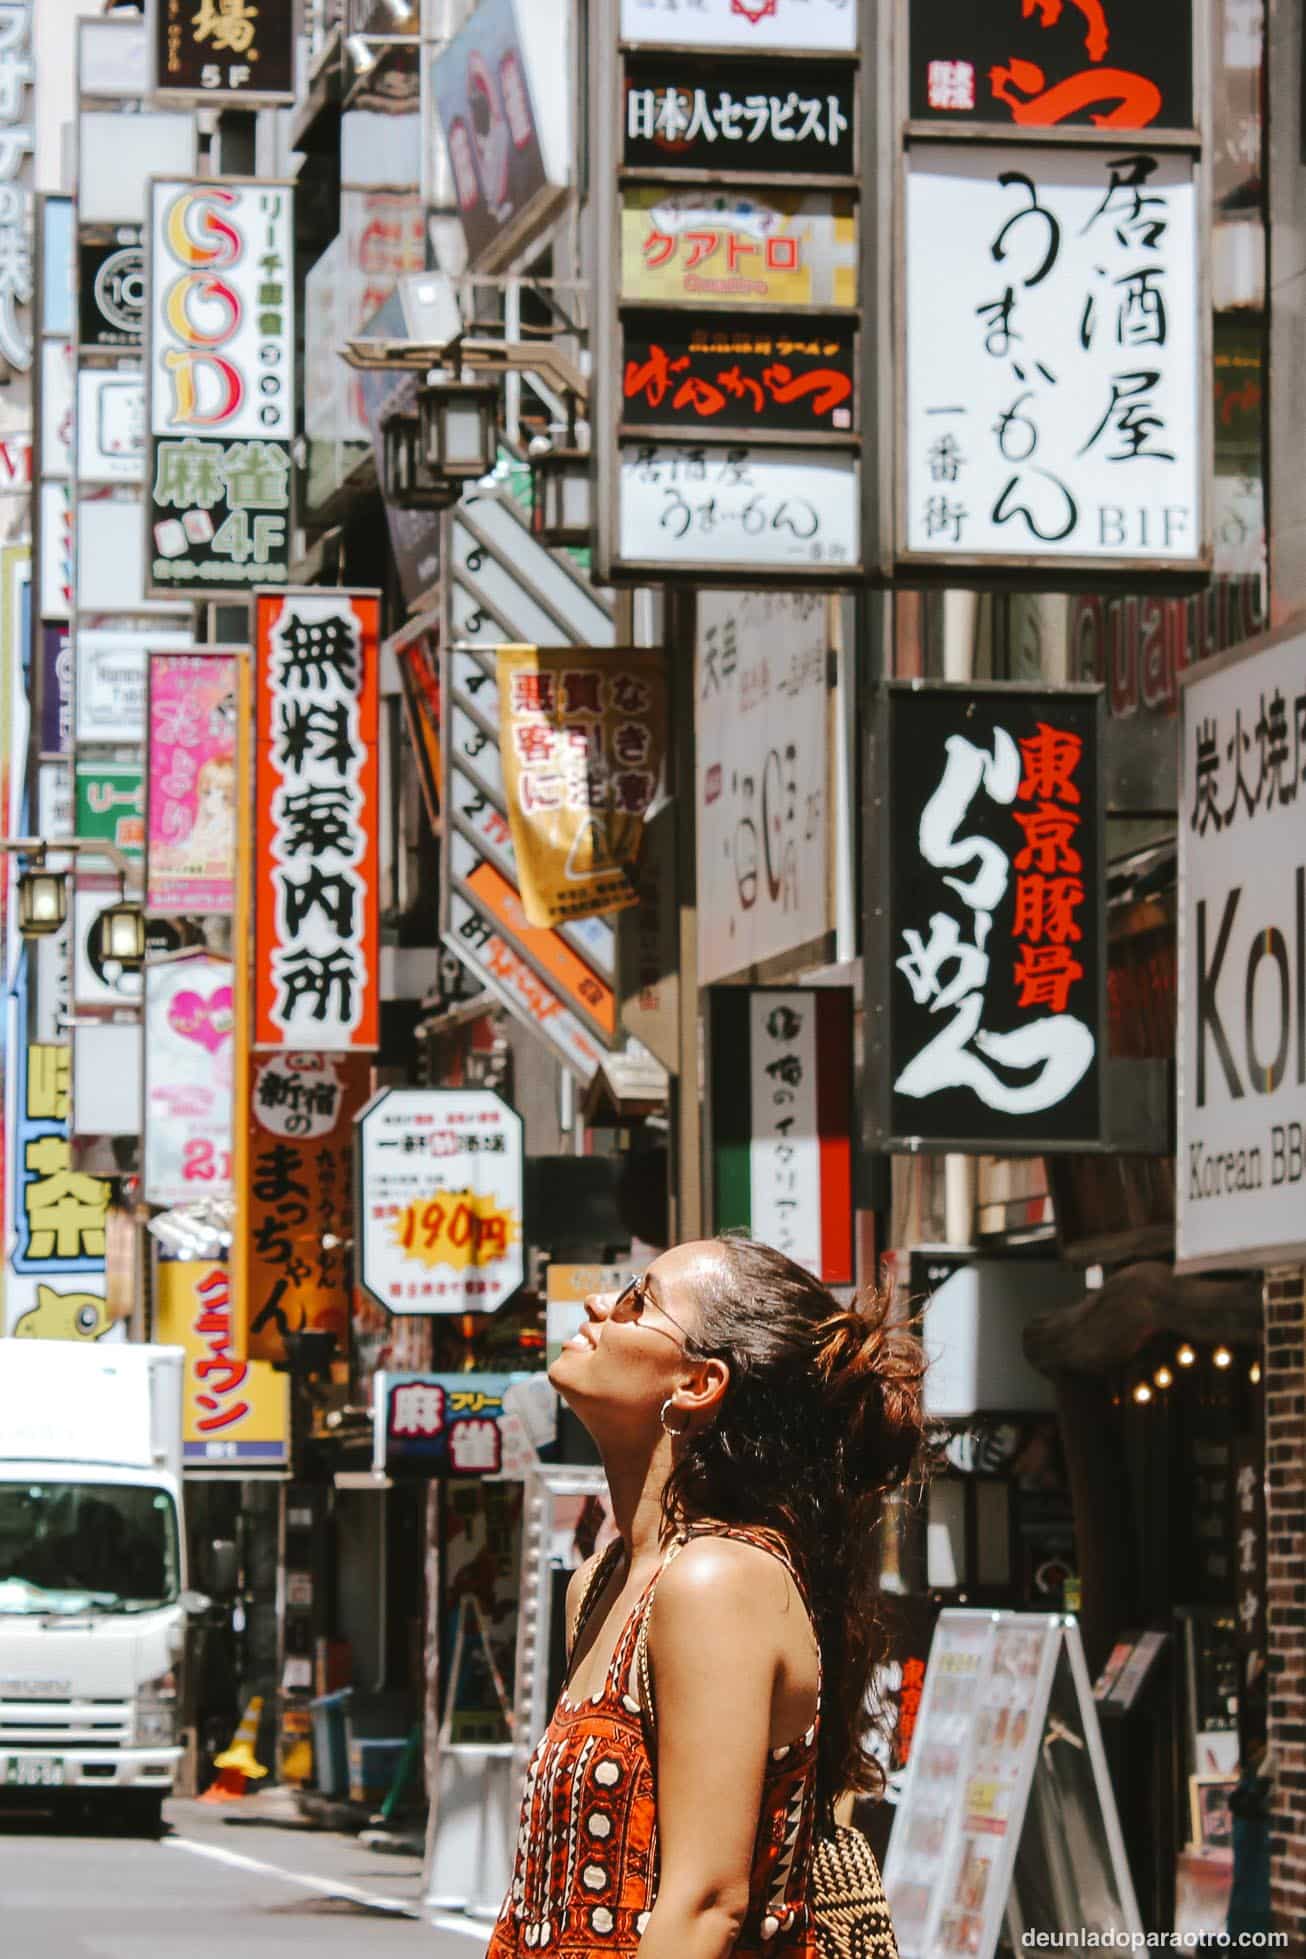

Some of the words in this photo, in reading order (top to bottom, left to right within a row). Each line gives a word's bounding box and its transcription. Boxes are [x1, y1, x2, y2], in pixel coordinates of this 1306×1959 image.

[200, 64, 250, 88] 5F
[627, 88, 848, 145] 日本人セラピスト
[643, 228, 799, 272] クアトロ
[164, 187, 244, 427] GOD
[1076, 155, 1177, 463] 居酒屋
[976, 171, 1077, 541] うまいもん
[153, 438, 291, 510] 麻雀
[925, 404, 970, 544] 一番街
[211, 510, 286, 563] 4F
[1098, 505, 1190, 547] B1F
[279, 612, 358, 1022] 無料案内所
[1012, 721, 1085, 1013] 東京豚骨
[1189, 1142, 1263, 1201] Korean
[1271, 1121, 1306, 1187] BB
